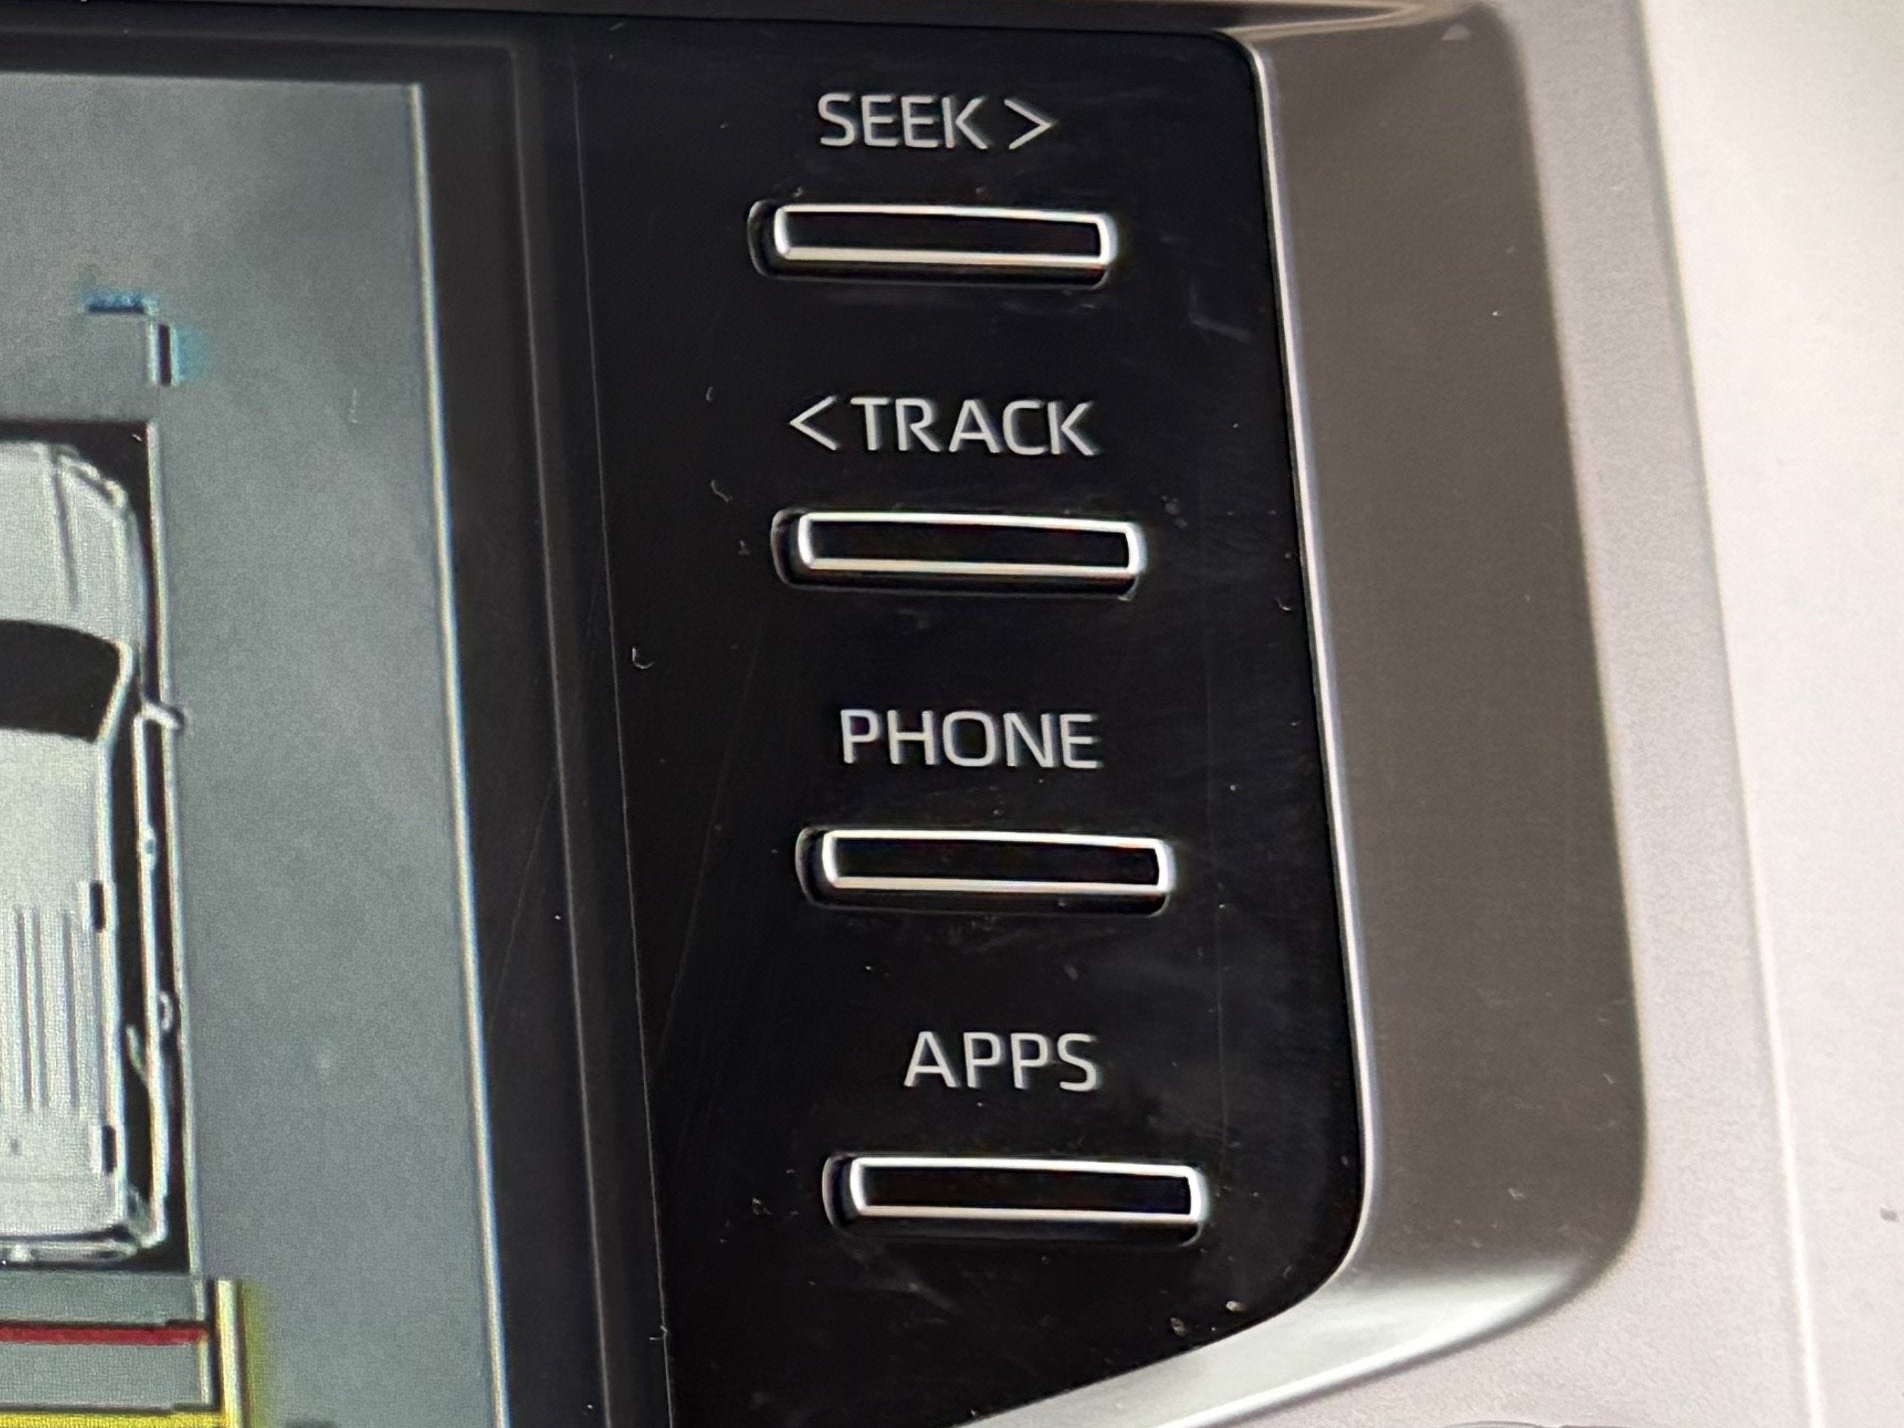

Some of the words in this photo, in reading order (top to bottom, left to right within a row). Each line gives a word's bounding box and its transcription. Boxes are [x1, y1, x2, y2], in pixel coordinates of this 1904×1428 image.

[817, 91, 989, 151] SEEK
[849, 395, 1096, 457] TRACK
[839, 708, 1100, 770] PHONE
[902, 1030, 1099, 1093] APPS
